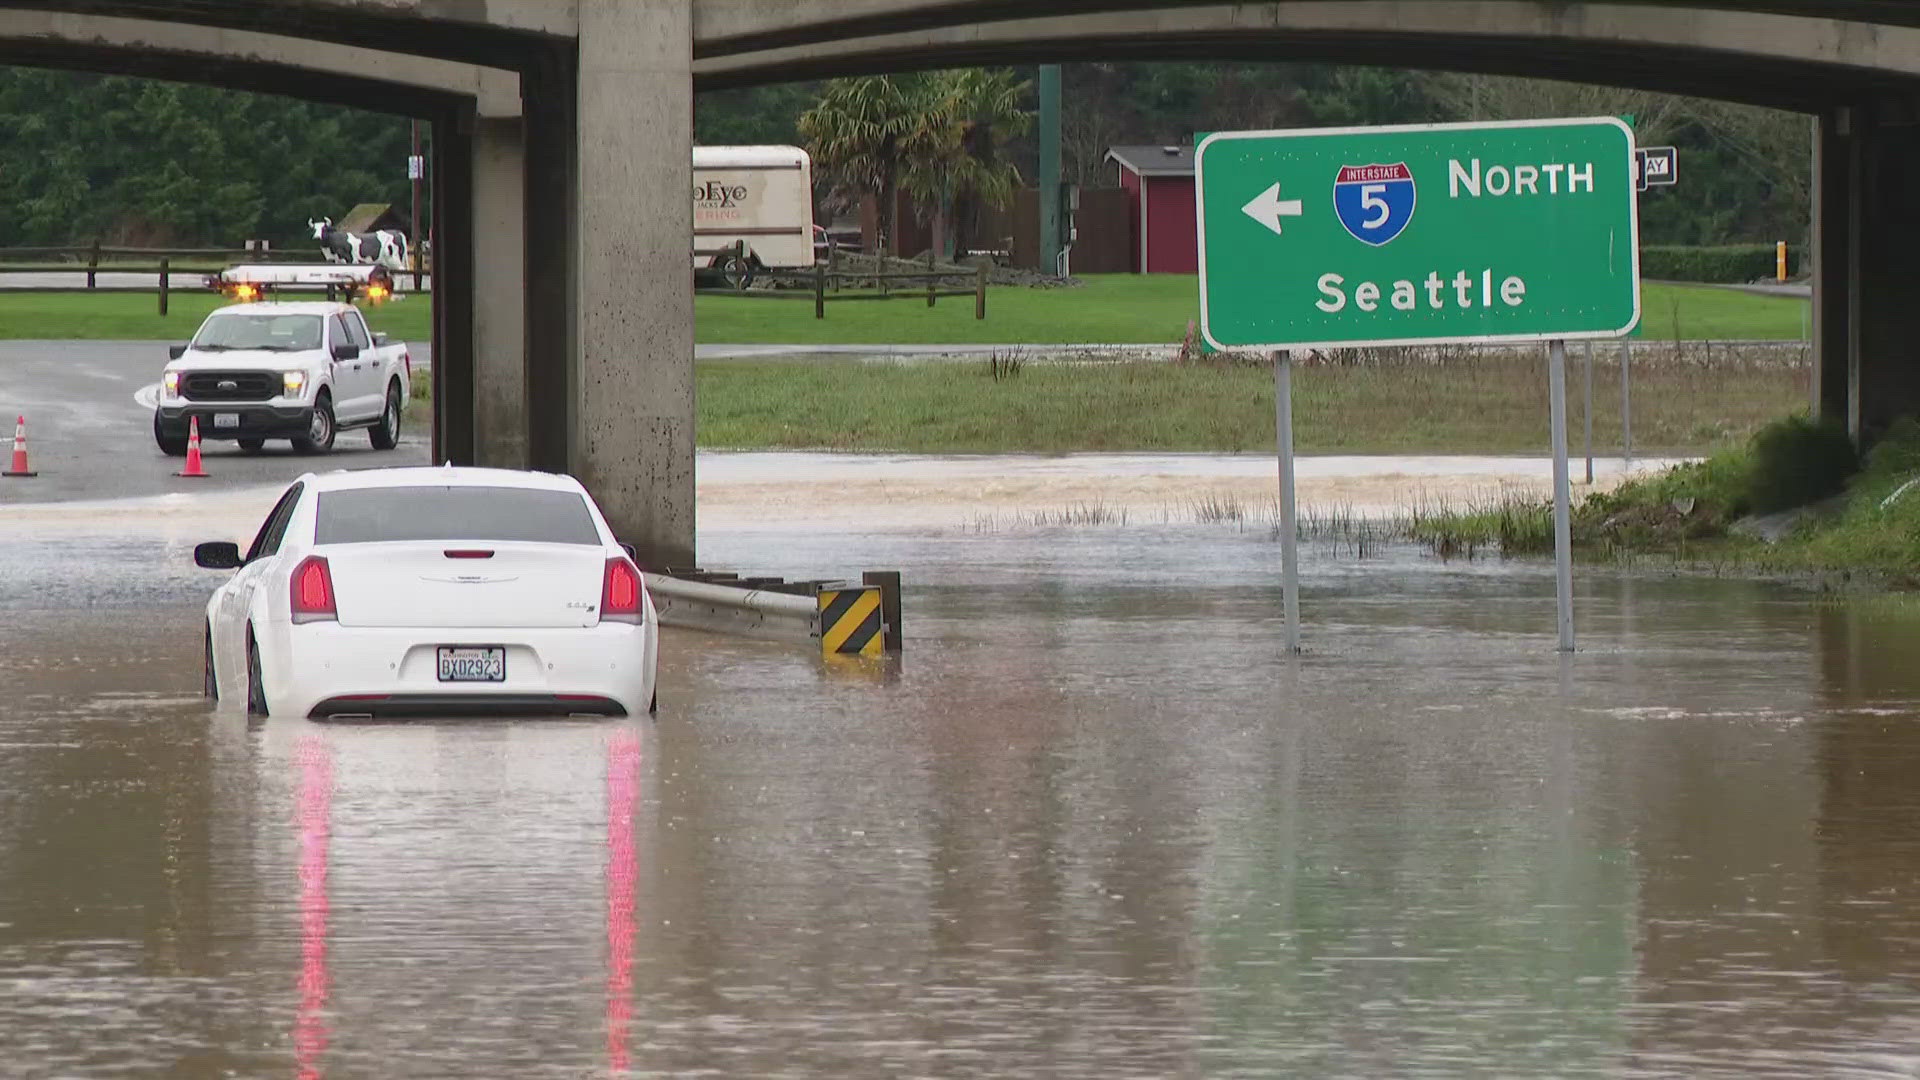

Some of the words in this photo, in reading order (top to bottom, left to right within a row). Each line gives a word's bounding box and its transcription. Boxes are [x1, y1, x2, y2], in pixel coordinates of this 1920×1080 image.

[1346, 167, 1400, 181] INTERSTATE
[1448, 158, 1594, 198] NORTH
[1361, 184, 1390, 229] 5
[1314, 267, 1526, 312] Seattle
[442, 659, 501, 675] BXD2923
